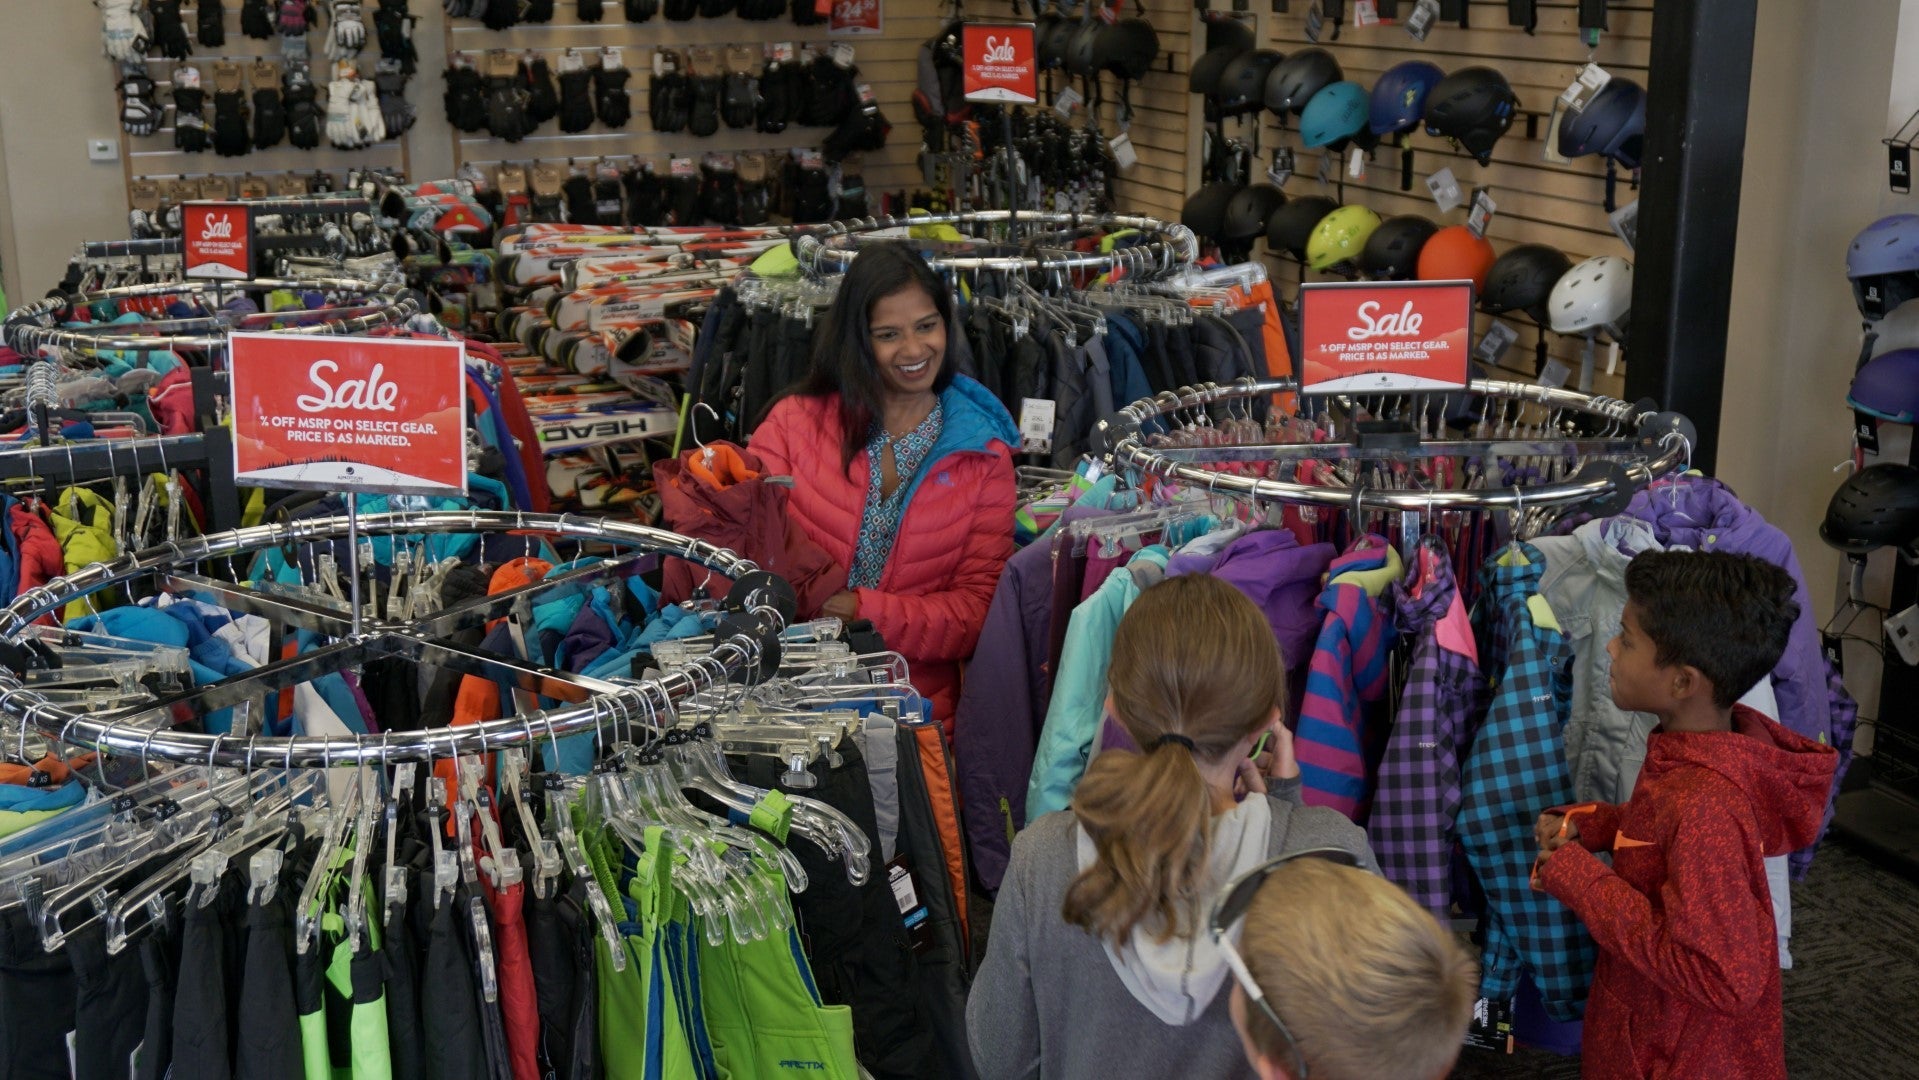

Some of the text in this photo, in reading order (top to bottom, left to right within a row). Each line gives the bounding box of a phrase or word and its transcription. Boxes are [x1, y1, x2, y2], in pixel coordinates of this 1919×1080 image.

[983, 35, 1016, 63] Sale
[201, 212, 233, 240] Sale
[513, 242, 558, 251] HEAD
[1347, 300, 1423, 340] Sale
[1328, 343, 1347, 352] OFF
[1348, 342, 1373, 352] MSRP
[1374, 342, 1389, 351] ON
[1390, 341, 1421, 350] SELECT
[1423, 340, 1450, 350] GEAR.
[1339, 350, 1430, 361] PRICE IS AS MARKED.
[296, 359, 399, 413] Sale
[260, 415, 438, 435] % OFF MSRP ON SELECT GEAR.
[544, 417, 647, 442] HEAD
[287, 430, 411, 447] PRICE IS AS MARKED.
[696, 726, 706, 735] XS
[778, 1059, 825, 1071] ARCTIX
